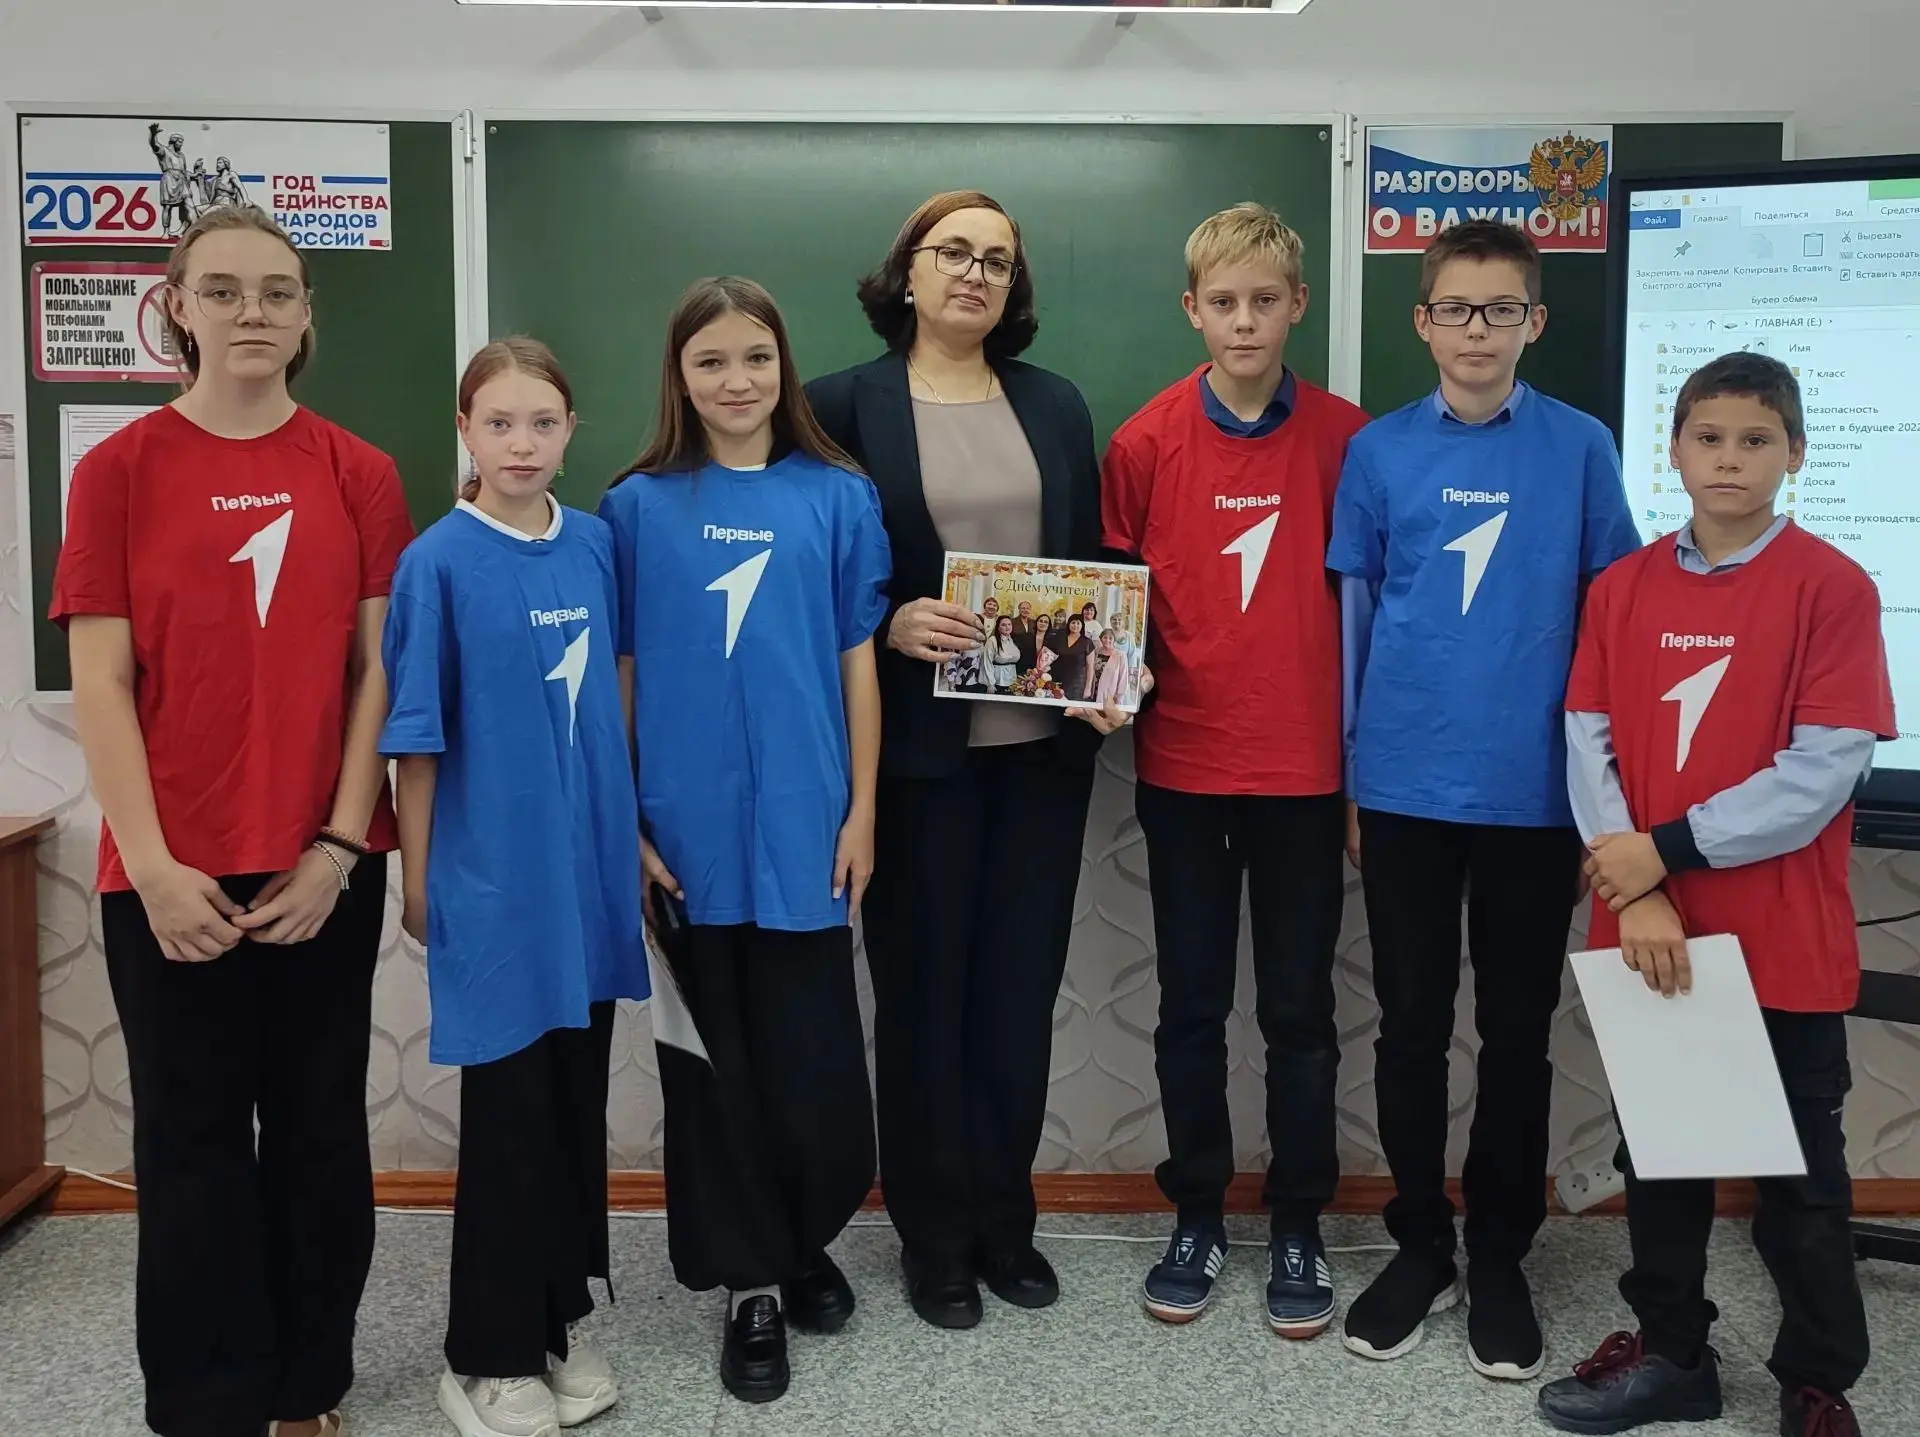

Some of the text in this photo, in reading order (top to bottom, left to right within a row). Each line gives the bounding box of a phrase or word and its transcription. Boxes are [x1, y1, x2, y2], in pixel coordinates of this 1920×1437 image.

[272, 175, 316, 192] ГОД
[1374, 170, 1534, 194] РАЗГОВОРЫ
[25, 184, 157, 231] 2026
[273, 194, 388, 211] ЕДИНСТВА
[1754, 211, 1809, 221] Поделиться
[1835, 209, 1854, 218] Вид
[1880, 206, 1920, 216] Средств
[274, 213, 378, 230] НАРОДОВ
[1372, 207, 1401, 238] О
[1643, 215, 1667, 225] Файл
[1693, 214, 1729, 223] Главная
[289, 231, 364, 246] ОССИИ
[1857, 232, 1902, 241] Вырезать
[1856, 251, 1920, 261] Скопировать
[1636, 269, 1682, 278] Закрепить
[1697, 268, 1729, 276] панели
[1733, 265, 1788, 276] Копировать
[1792, 265, 1833, 273] Вставить
[1856, 270, 1897, 279] Вставить
[45, 278, 137, 296] ПОЛЬЗОВАНИЕ
[1642, 280, 1722, 290] быстрого доступа
[1751, 295, 1818, 304] Буфер обмена
[45, 299, 112, 311] МОБИЛЬНЫМИ
[45, 314, 105, 327] ТЕЛЕФОНАМИ
[1754, 318, 1804, 328] ГЛАВНАЯ
[47, 329, 125, 343] ВО ВРЕМЯ УРОКА
[1670, 346, 1715, 355] Загрузки
[1789, 344, 1811, 352] Имя
[46, 347, 136, 368] ЗАПРЕЩЕНО!
[1807, 369, 1846, 378] 7 класс
[1807, 387, 1819, 396] 23
[1806, 405, 1880, 414] Безопасность
[1806, 424, 1836, 432] Билет
[1848, 423, 1895, 434] будущее
[1805, 441, 1862, 451] Горизонты
[1804, 459, 1850, 469] Грамоты
[1803, 477, 1836, 486] Доска
[211, 492, 291, 511] Первые
[1214, 493, 1281, 512] Первые
[1442, 488, 1510, 507] Первые
[1803, 497, 1846, 505] история
[1659, 511, 1681, 520] Этот
[1802, 513, 1852, 522] Классное
[703, 524, 774, 544] Первые
[1816, 532, 1862, 541] нец года
[993, 578, 1099, 597] С Днём учителя!
[529, 606, 589, 627] Первые
[1660, 632, 1735, 652] Первые
